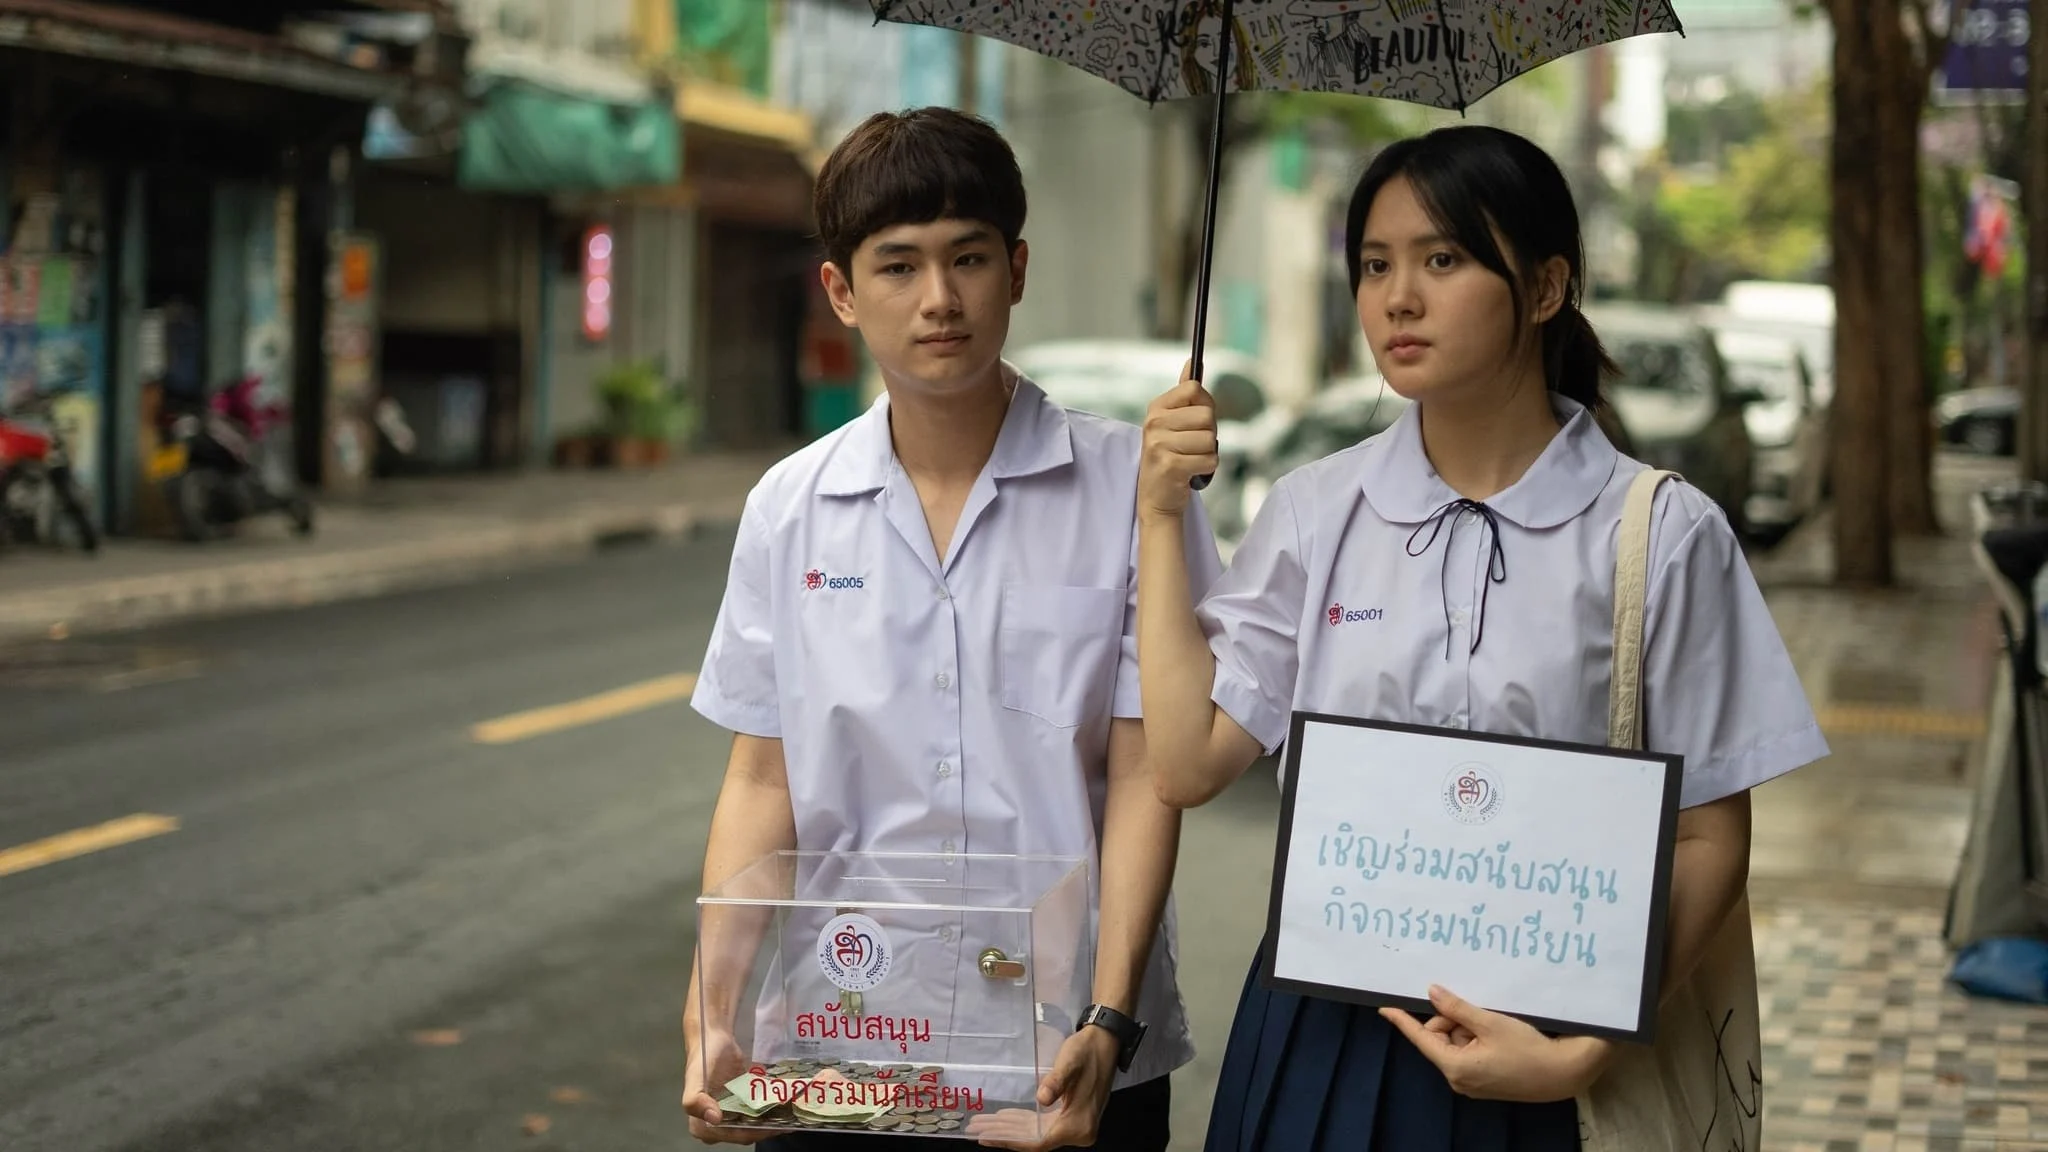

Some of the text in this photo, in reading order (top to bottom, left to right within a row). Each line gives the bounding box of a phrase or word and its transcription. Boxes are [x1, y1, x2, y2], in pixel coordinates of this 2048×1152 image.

[829, 576, 864, 589] 65005
[1345, 608, 1383, 622] 65001
[1317, 822, 1618, 925] เชิญร่วมสนับสนุน
[1324, 886, 1598, 969] กิจกรรมนักเรียน
[796, 1002, 930, 1053] สนับสนุน
[747, 1064, 985, 1112] กิจกรรมนักเรียน
